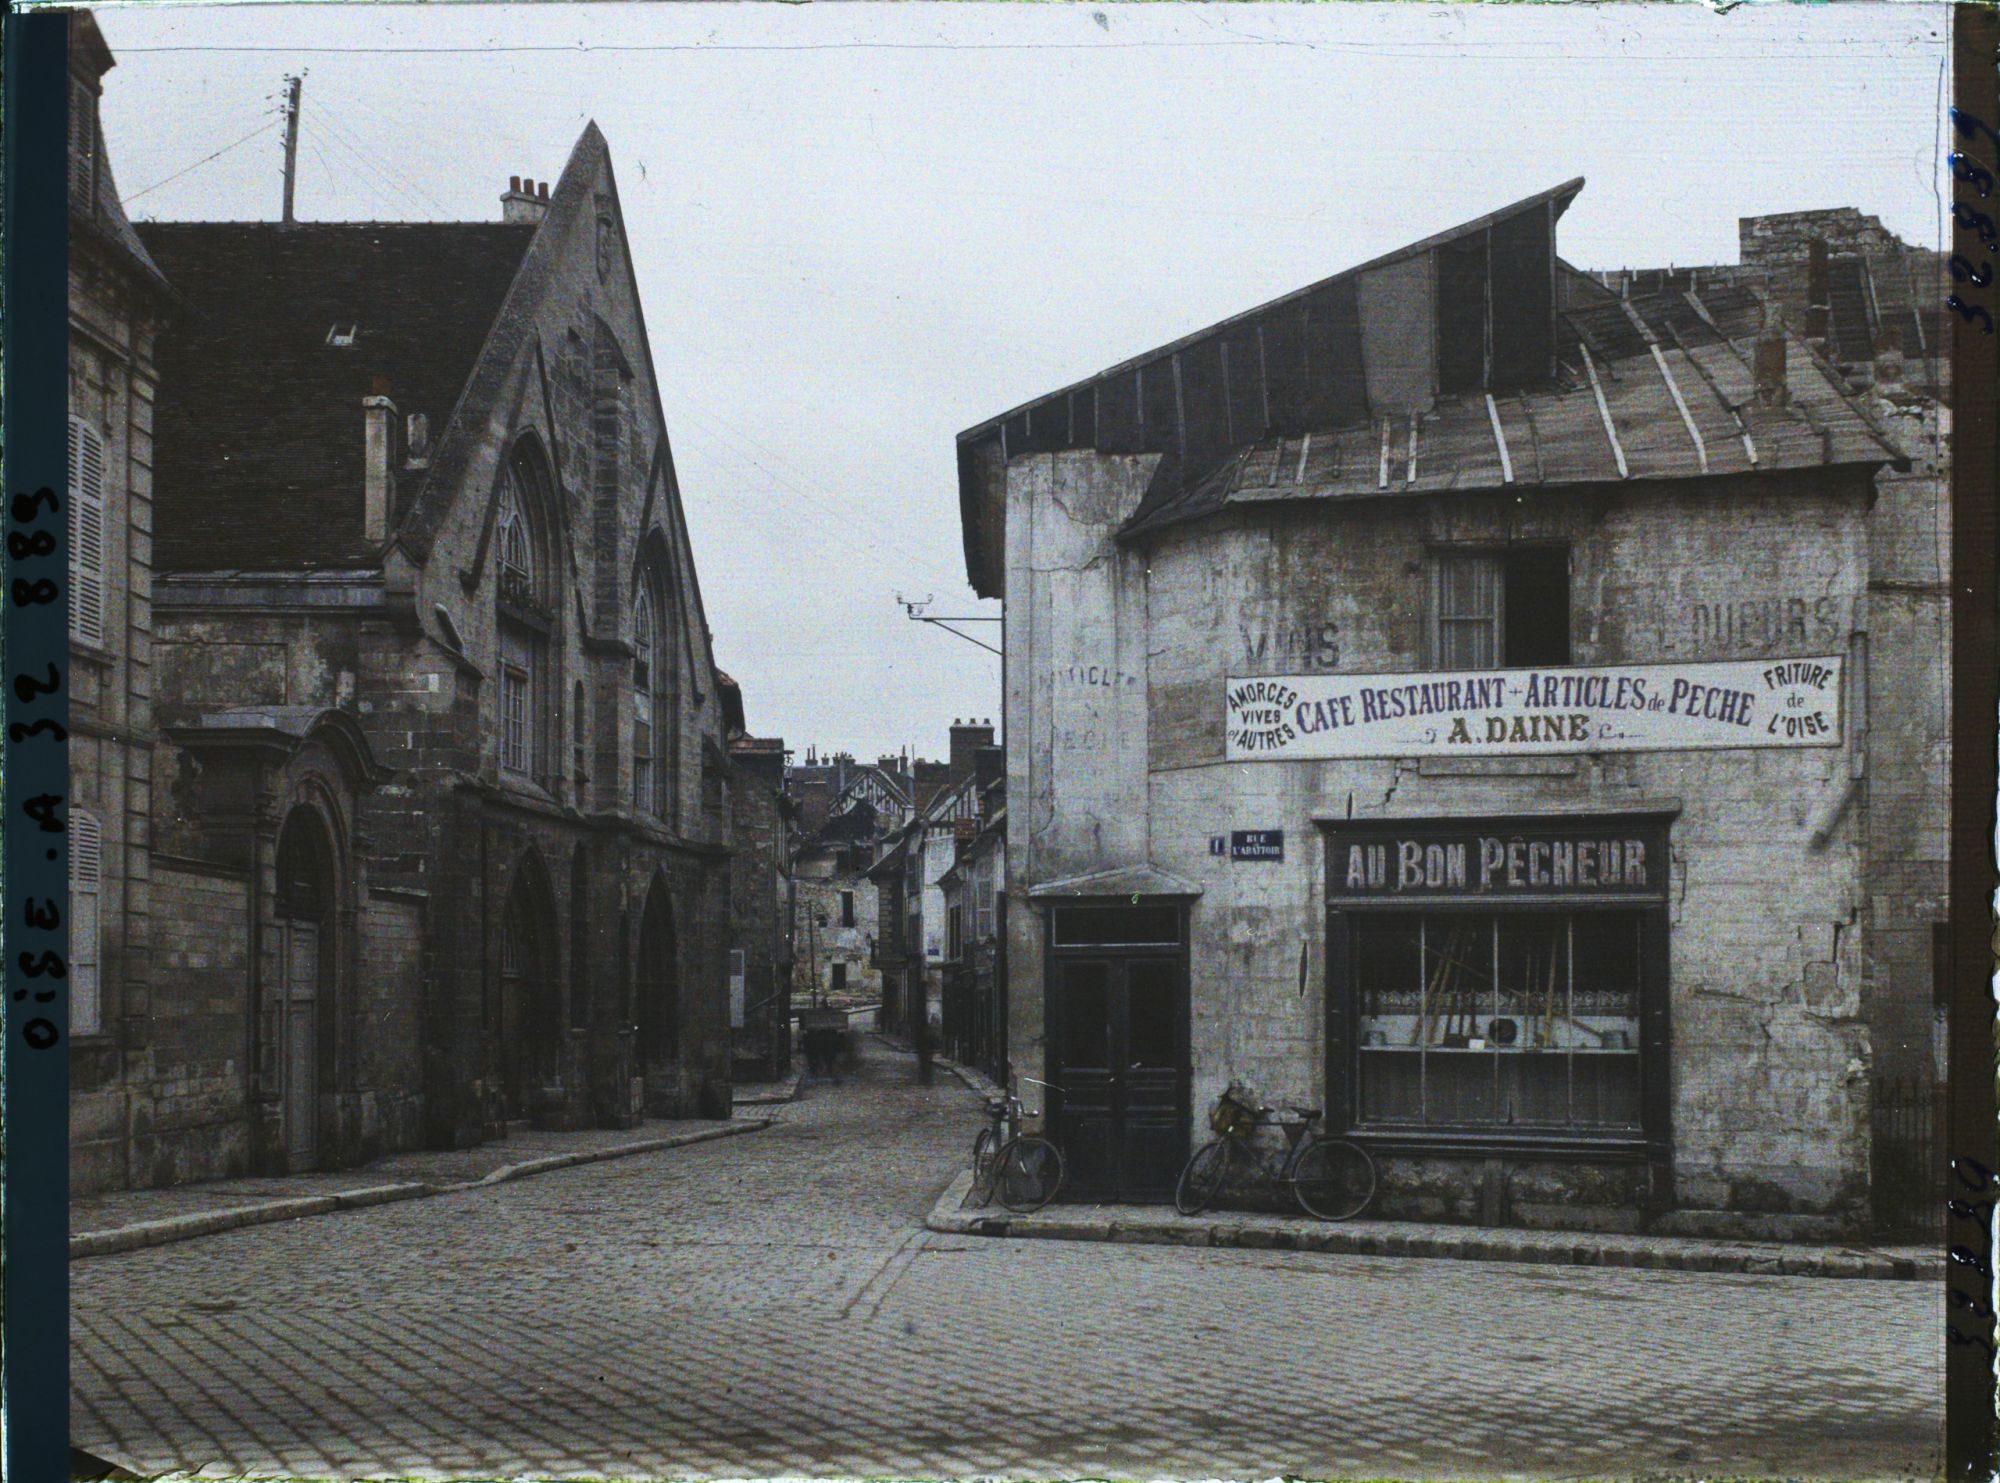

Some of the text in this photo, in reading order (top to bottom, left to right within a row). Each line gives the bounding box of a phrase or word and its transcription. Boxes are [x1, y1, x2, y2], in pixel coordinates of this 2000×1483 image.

[1763, 662, 1833, 690] FRITURE
[1228, 682, 1298, 713] AMORCES
[1296, 673, 1755, 735] CAFE RESTAURANT ARTICLES de PECHE
[1786, 692, 1806, 708] de
[1241, 709, 1281, 725] VIVES
[1767, 710, 1830, 738] L'OISE
[1236, 723, 1296, 751] AUTRES
[1346, 835, 1648, 892] AU BON PÊCHEUR
